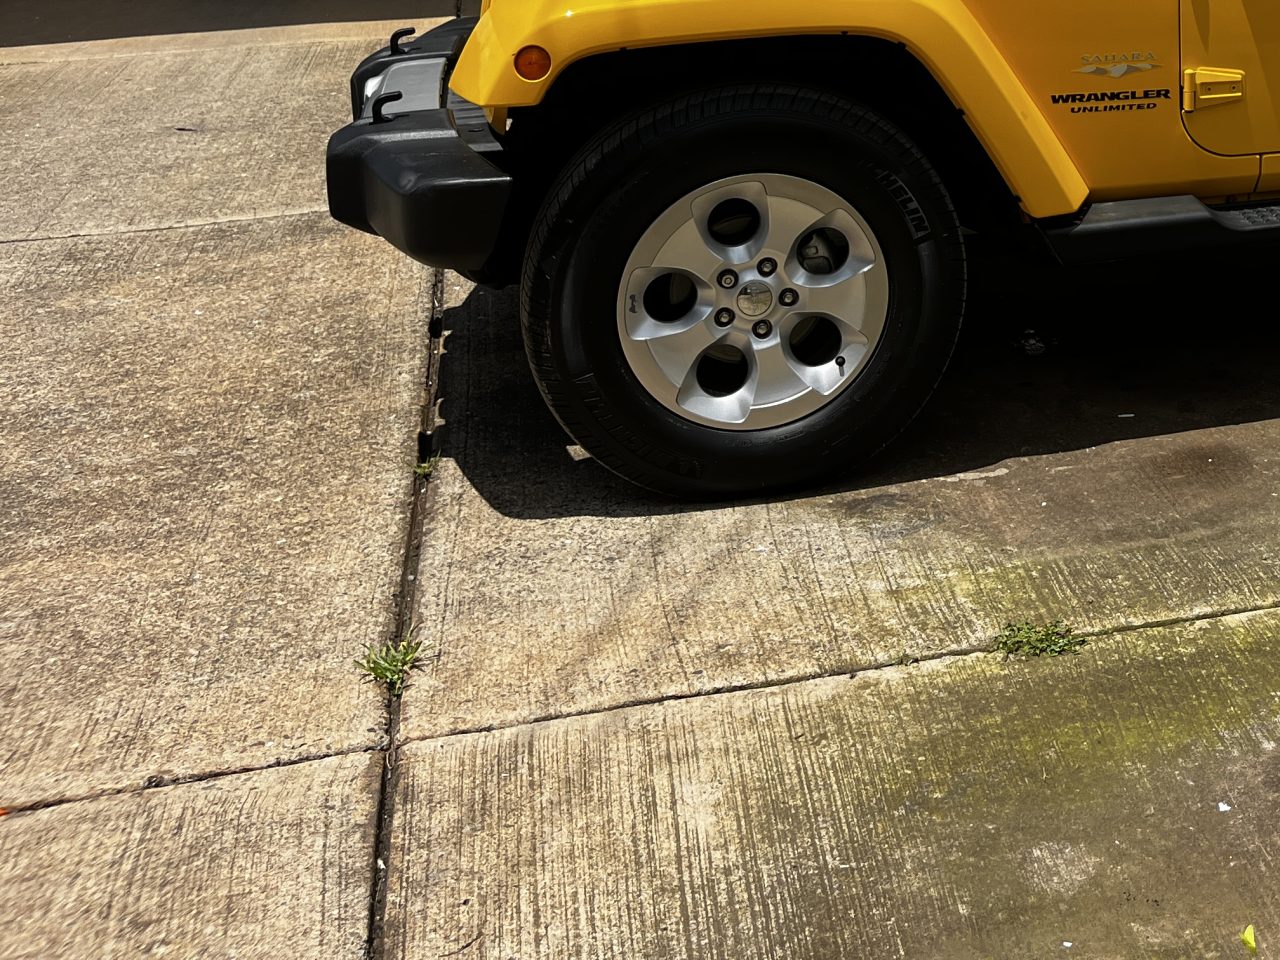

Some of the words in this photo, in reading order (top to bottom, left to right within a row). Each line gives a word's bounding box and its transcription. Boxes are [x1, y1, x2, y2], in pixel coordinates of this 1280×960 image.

[1080, 51, 1155, 64] SAHARA
[1051, 89, 1171, 104] WRANGLER
[1071, 102, 1157, 114] UNLIMITED
